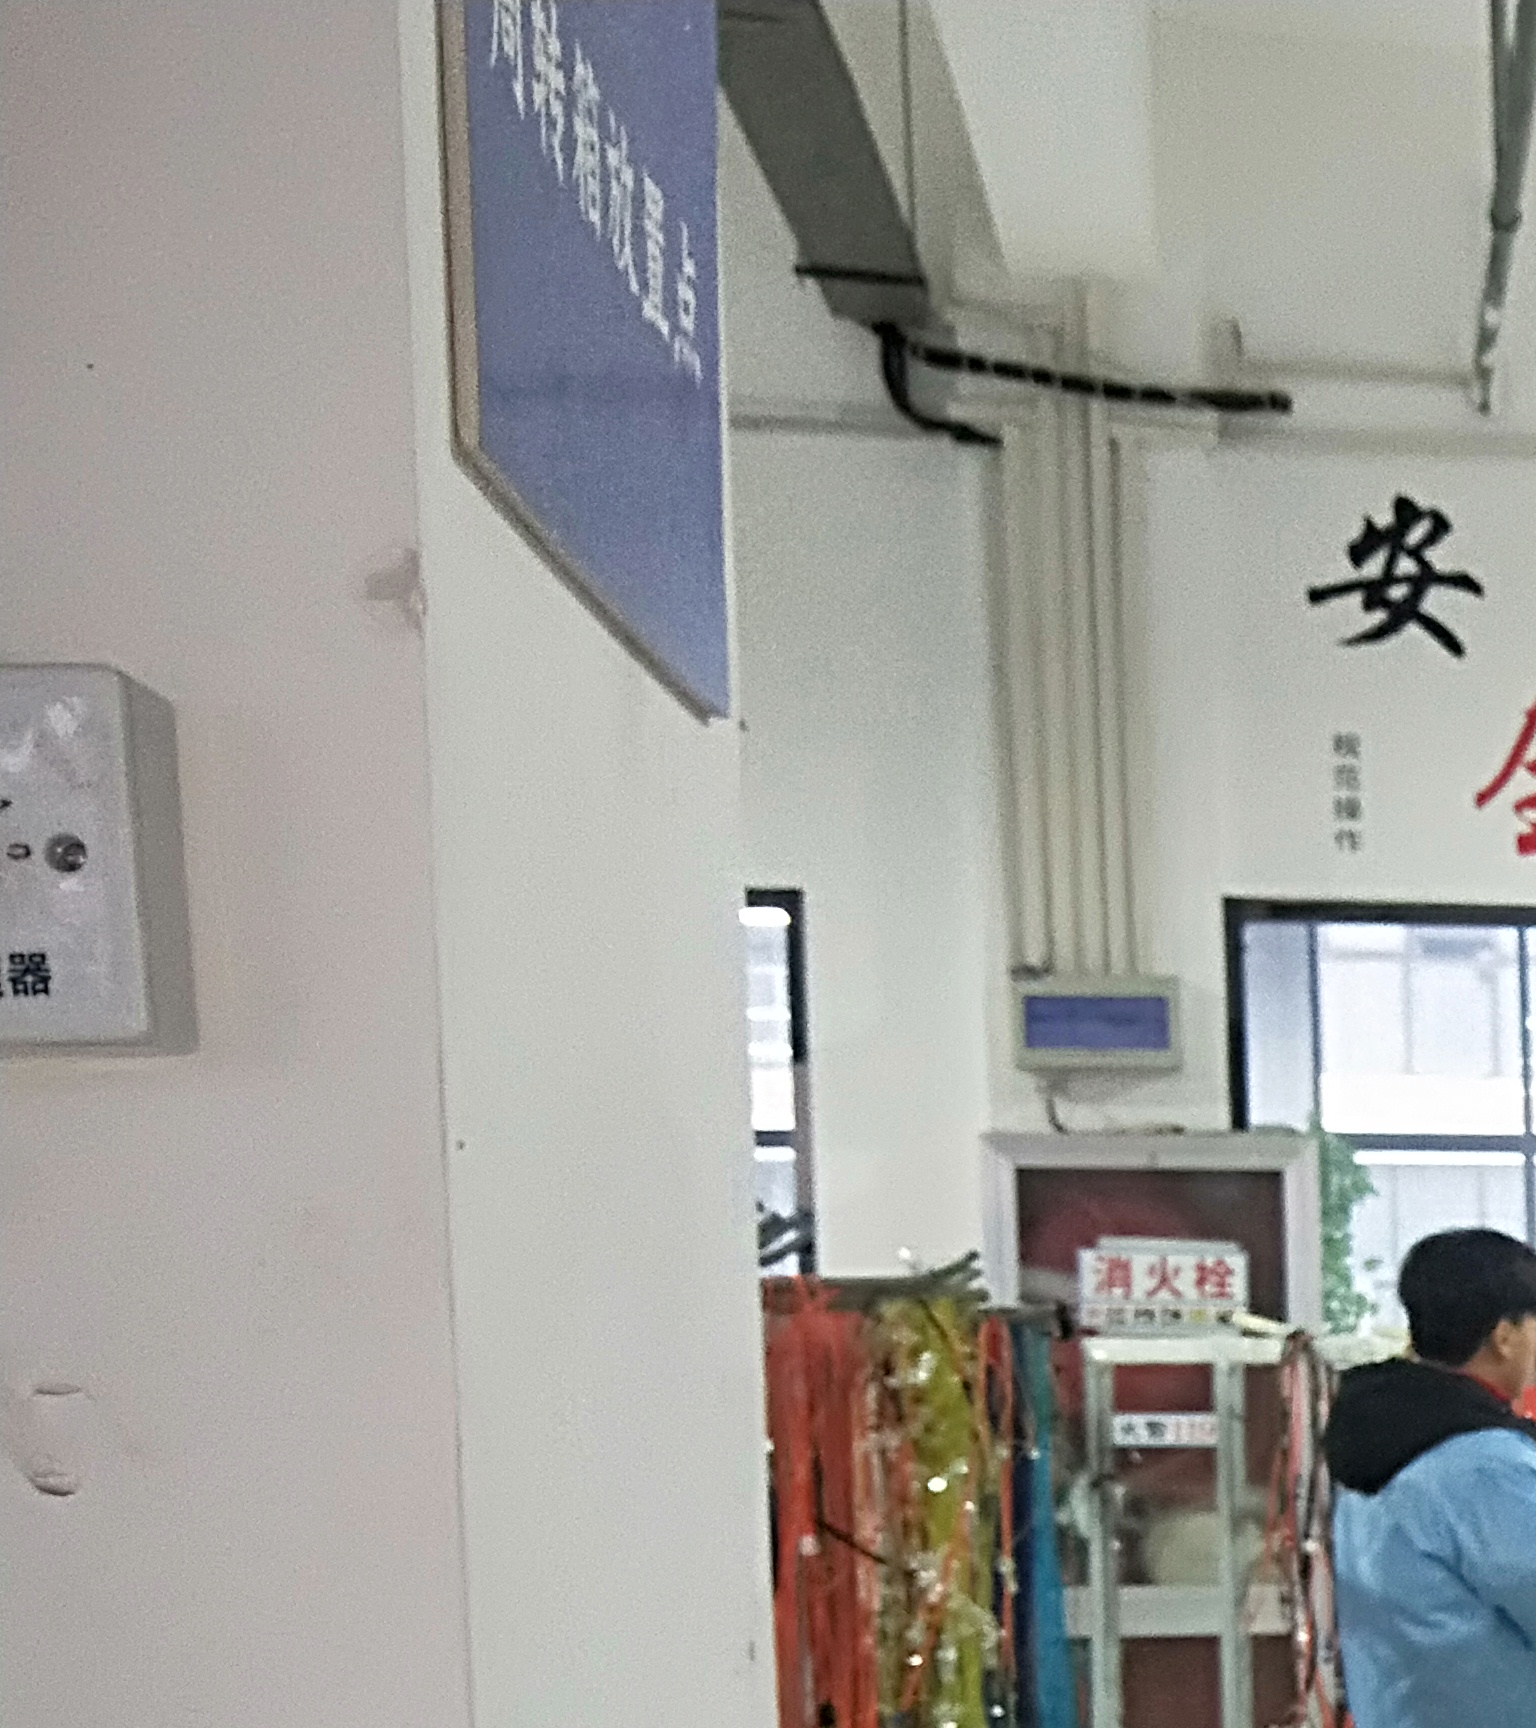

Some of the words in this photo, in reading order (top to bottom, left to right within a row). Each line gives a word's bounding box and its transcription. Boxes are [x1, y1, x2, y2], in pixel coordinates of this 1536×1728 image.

[1307, 495, 1485, 659] 安
[1094, 1255, 1235, 1301] 消火栓
